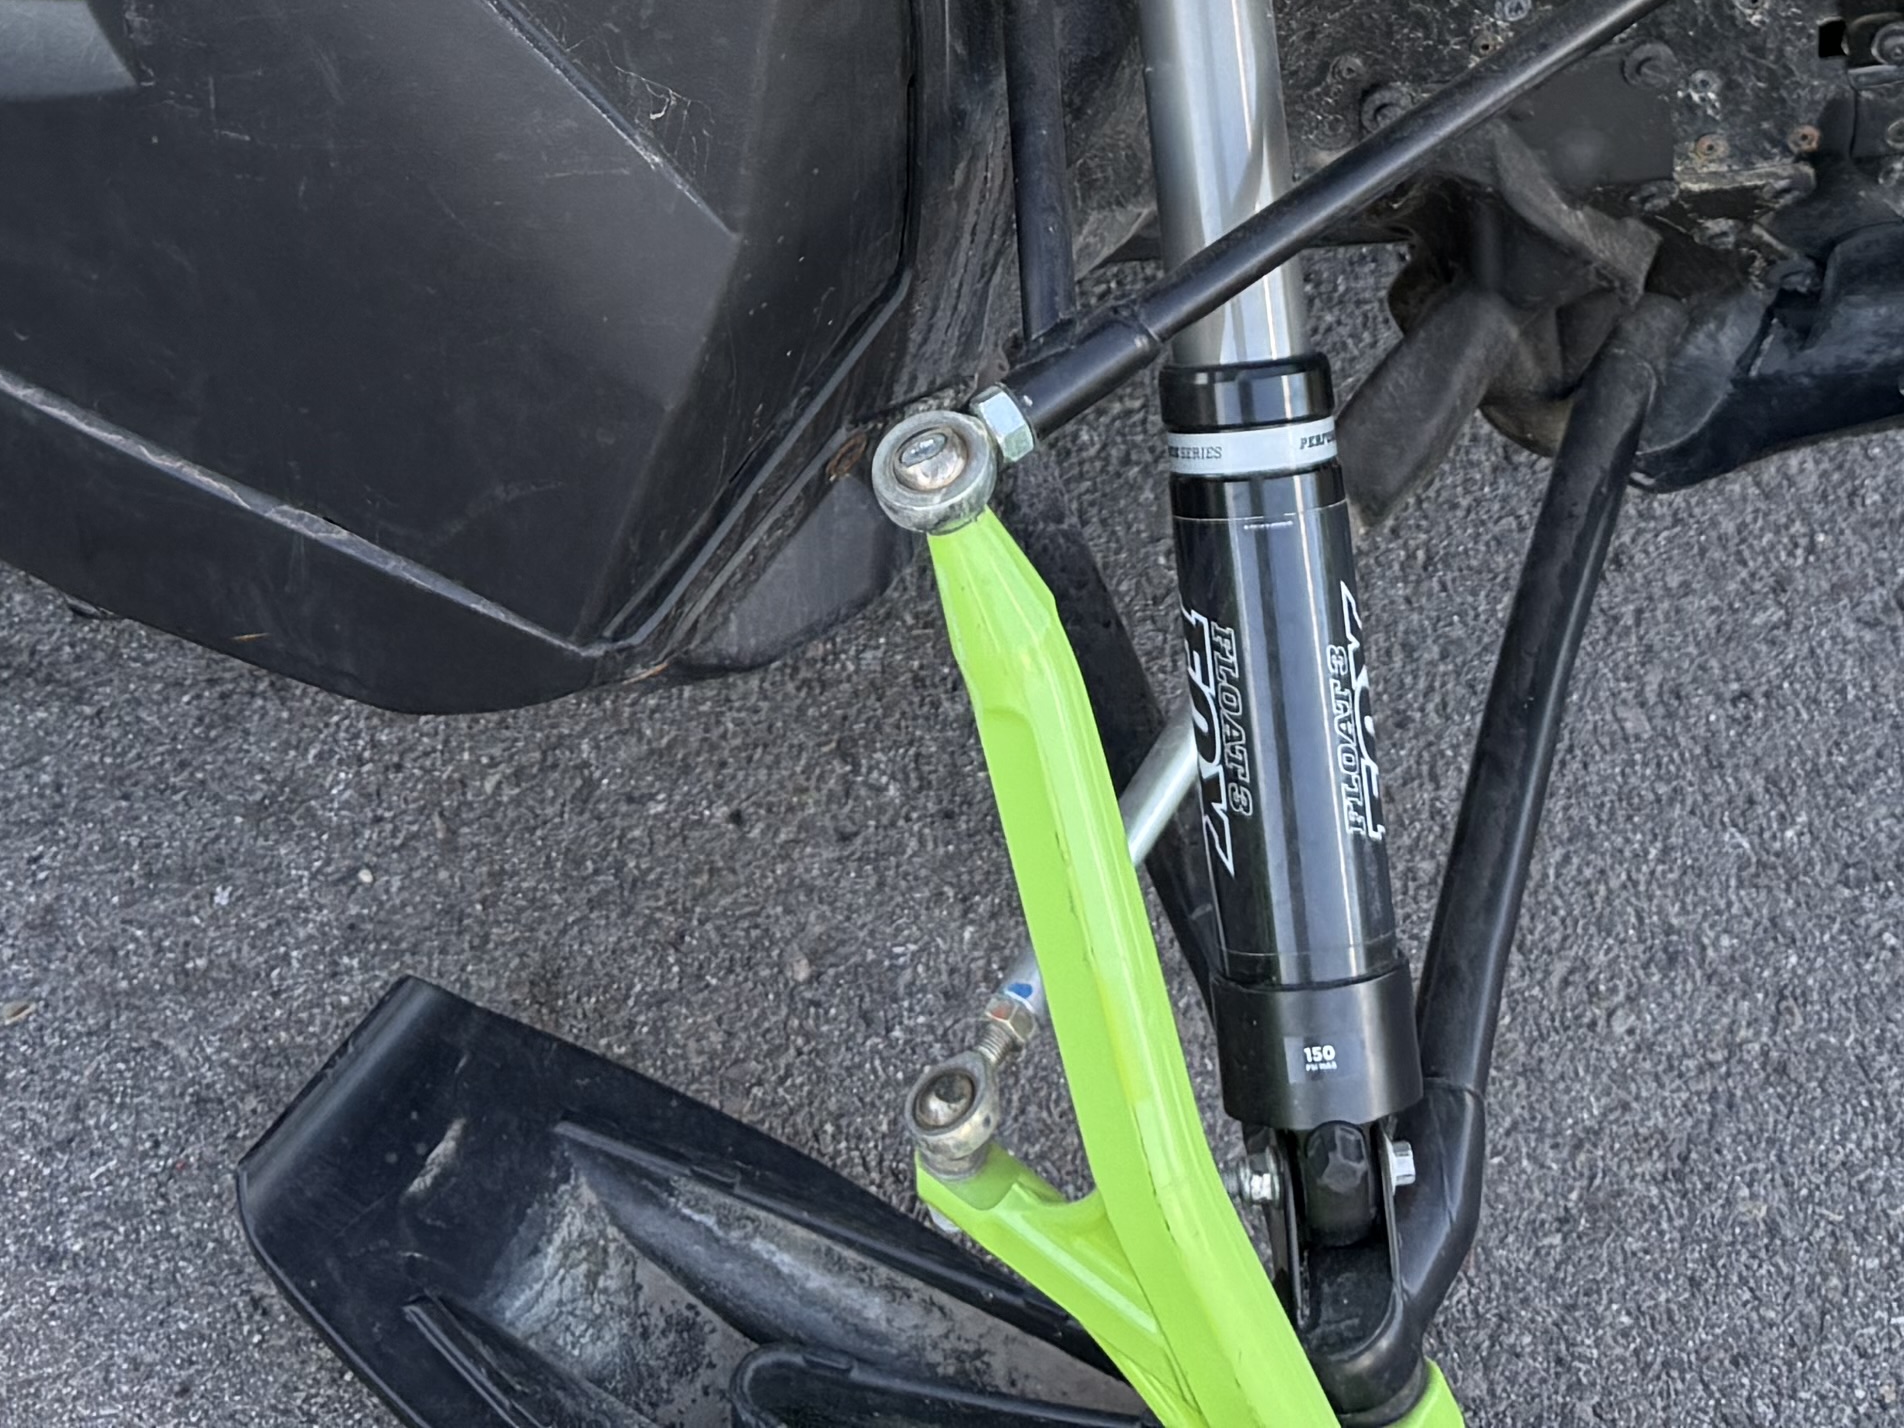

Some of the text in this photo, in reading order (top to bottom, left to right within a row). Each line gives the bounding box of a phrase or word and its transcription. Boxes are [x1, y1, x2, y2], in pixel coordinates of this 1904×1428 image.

[1209, 621, 1253, 817] FLOAT 3
[1326, 644, 1369, 836] FLOAT 3
[1303, 1045, 1336, 1063] 150
